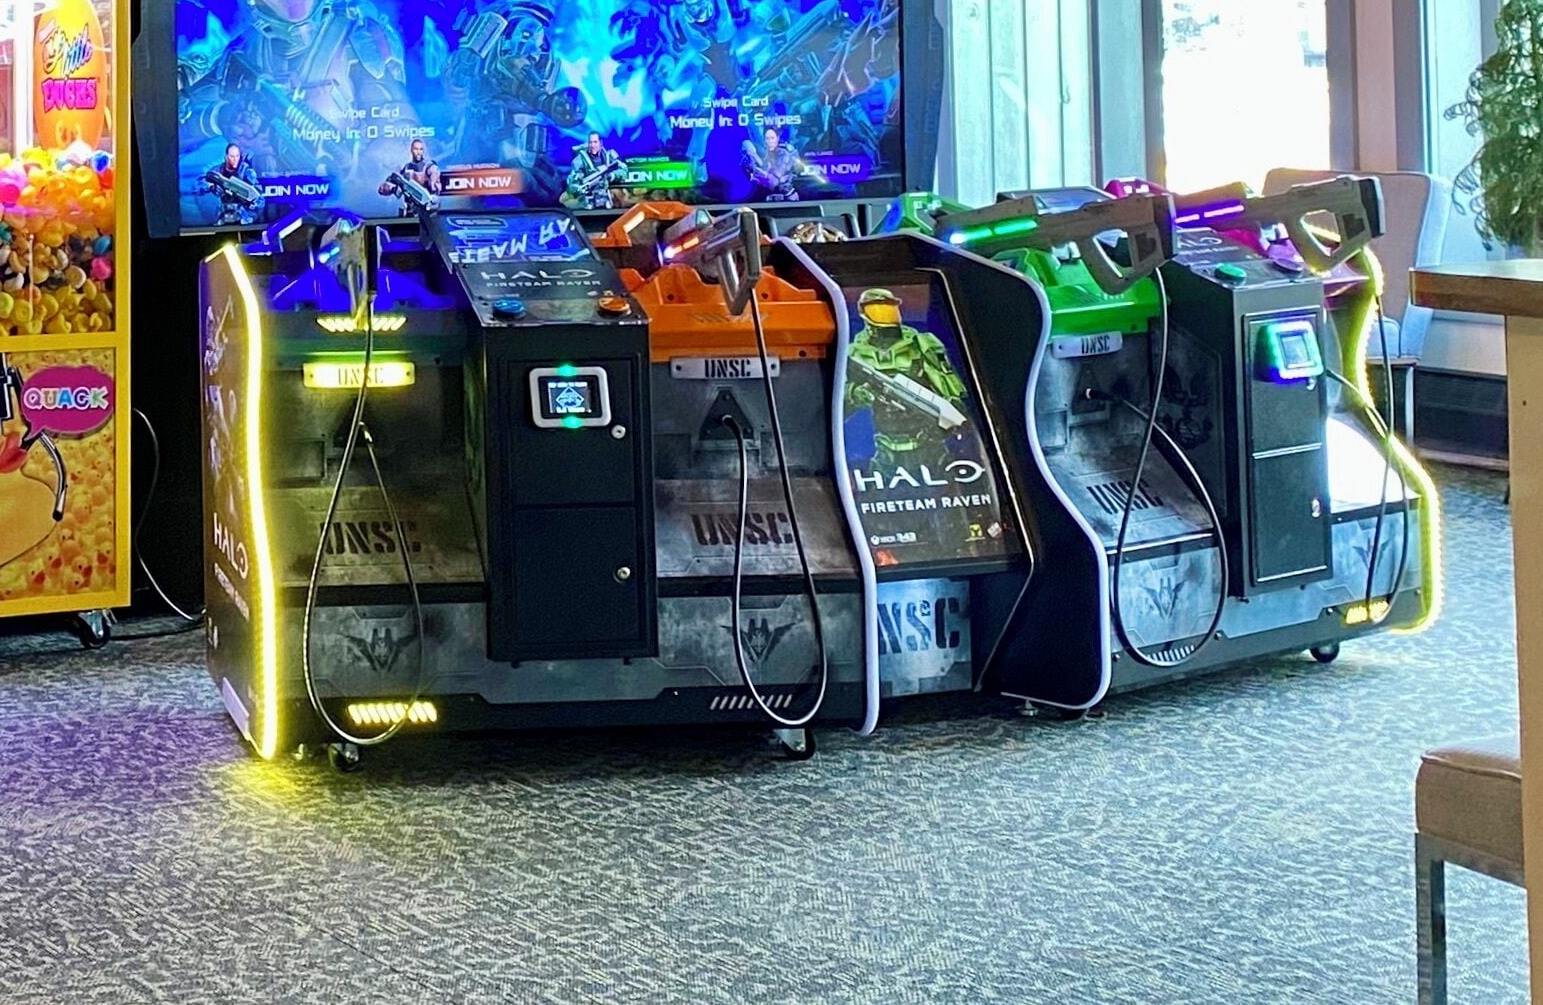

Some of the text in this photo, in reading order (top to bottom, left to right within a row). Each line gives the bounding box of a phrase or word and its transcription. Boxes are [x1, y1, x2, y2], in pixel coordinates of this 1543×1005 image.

[41, 77, 97, 113] DUCKS
[703, 95, 769, 109] Swipe Card
[371, 106, 400, 118] Card
[669, 115, 714, 130] Money
[754, 113, 802, 128] Swipes
[292, 127, 341, 143] Money
[383, 126, 436, 139] Swipes
[624, 169, 687, 182] JOIN NOW
[830, 163, 860, 174] NOW
[261, 183, 329, 197] JOIN NOW
[445, 176, 511, 190] JOIN NOW
[481, 268, 596, 280] HALO
[1081, 335, 1110, 354] UNSC
[704, 359, 752, 378] UNSC
[23, 386, 109, 410] QUACK
[854, 459, 986, 492] HALO
[860, 494, 992, 515] FIRETEAM RAVEN
[320, 521, 422, 555] UNSC
[691, 512, 794, 546] UNSC
[214, 512, 249, 580] HALO
[877, 597, 961, 655] NSC
